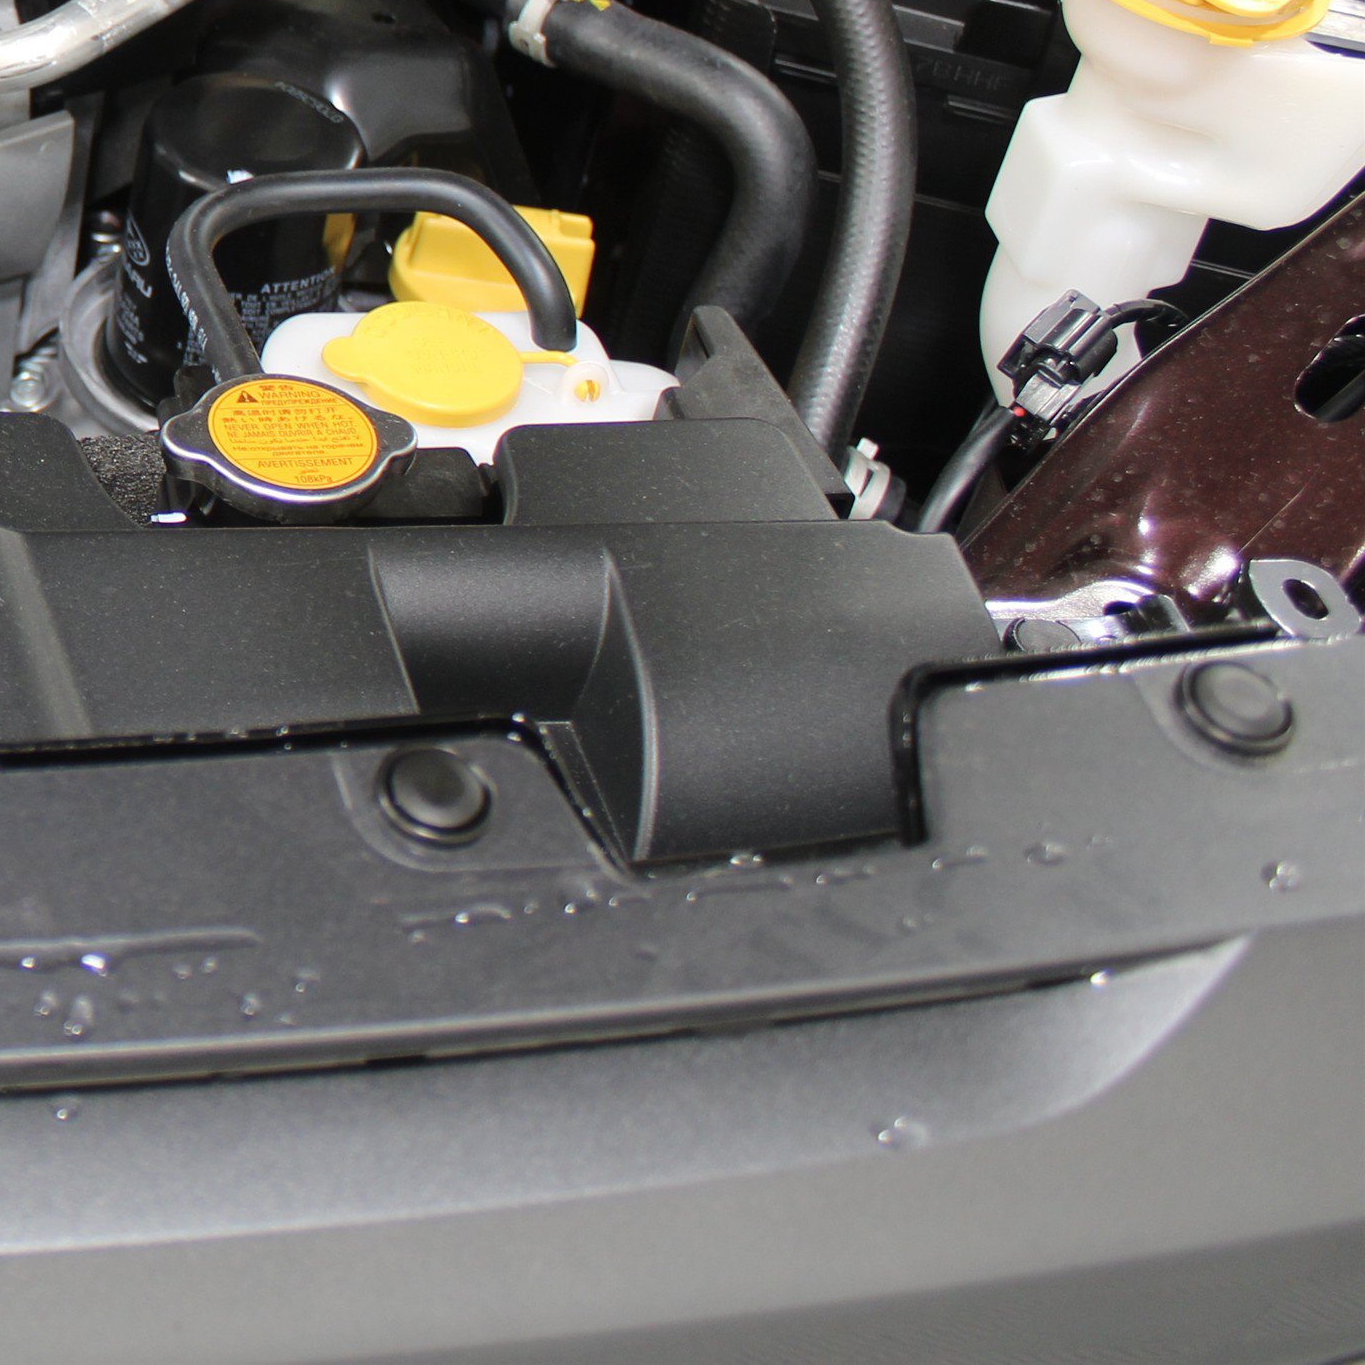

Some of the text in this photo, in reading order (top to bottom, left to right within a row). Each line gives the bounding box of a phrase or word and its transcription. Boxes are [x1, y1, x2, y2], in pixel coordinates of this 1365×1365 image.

[260, 391, 321, 399] WARNING
[224, 423, 259, 431] NEVER
[263, 422, 293, 430] OPEN
[243, 430, 276, 438] JAMAIS
[325, 427, 357, 435] CHAUD
[258, 457, 354, 469] AVERTISSEMENT
[295, 474, 332, 484] 108kPa
